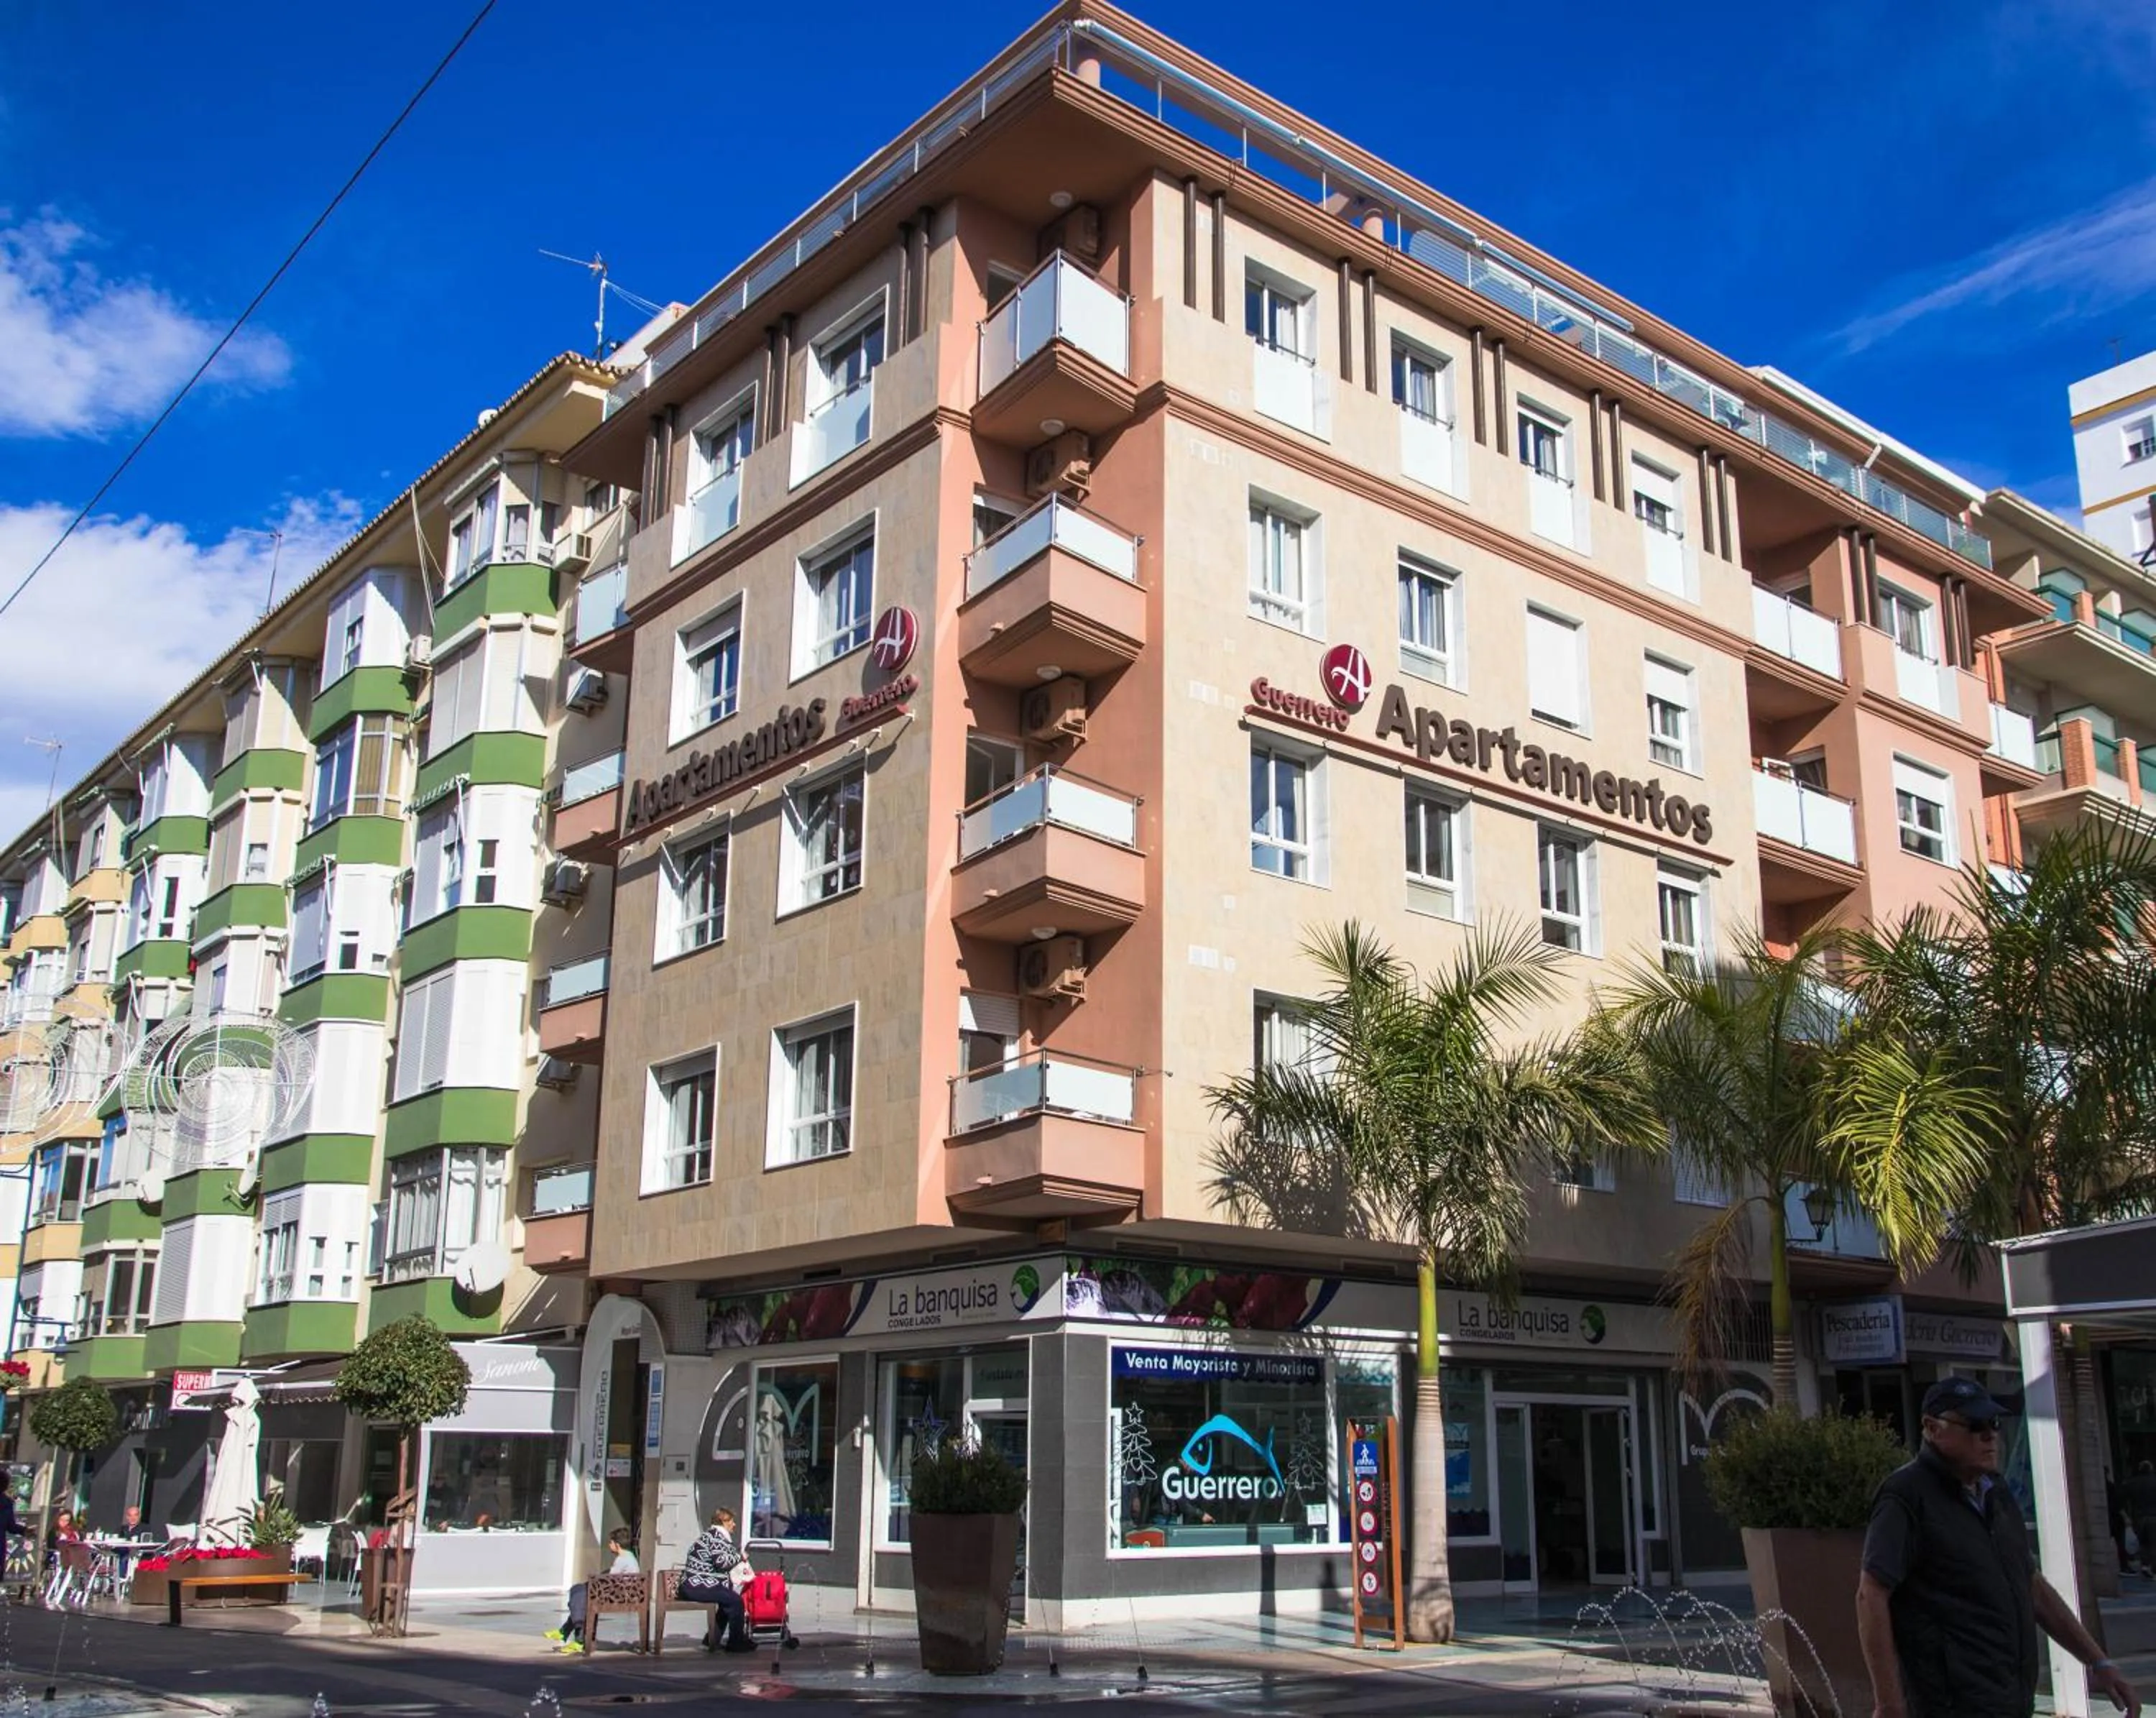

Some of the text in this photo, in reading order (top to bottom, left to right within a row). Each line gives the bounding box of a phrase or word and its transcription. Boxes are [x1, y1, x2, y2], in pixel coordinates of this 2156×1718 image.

[626, 674, 919, 834] Apartamentos Guerrero
[1250, 676, 1713, 845] Guerrero Apartamentos
[888, 1279, 998, 1318] La banquisa
[1458, 1299, 1570, 1338] La banquisa
[1460, 1328, 1516, 1341] CONGELADOS
[1125, 1352, 1316, 1377] Venta Mayorista y Minorista
[1162, 1466, 1278, 1500] Guerrero
